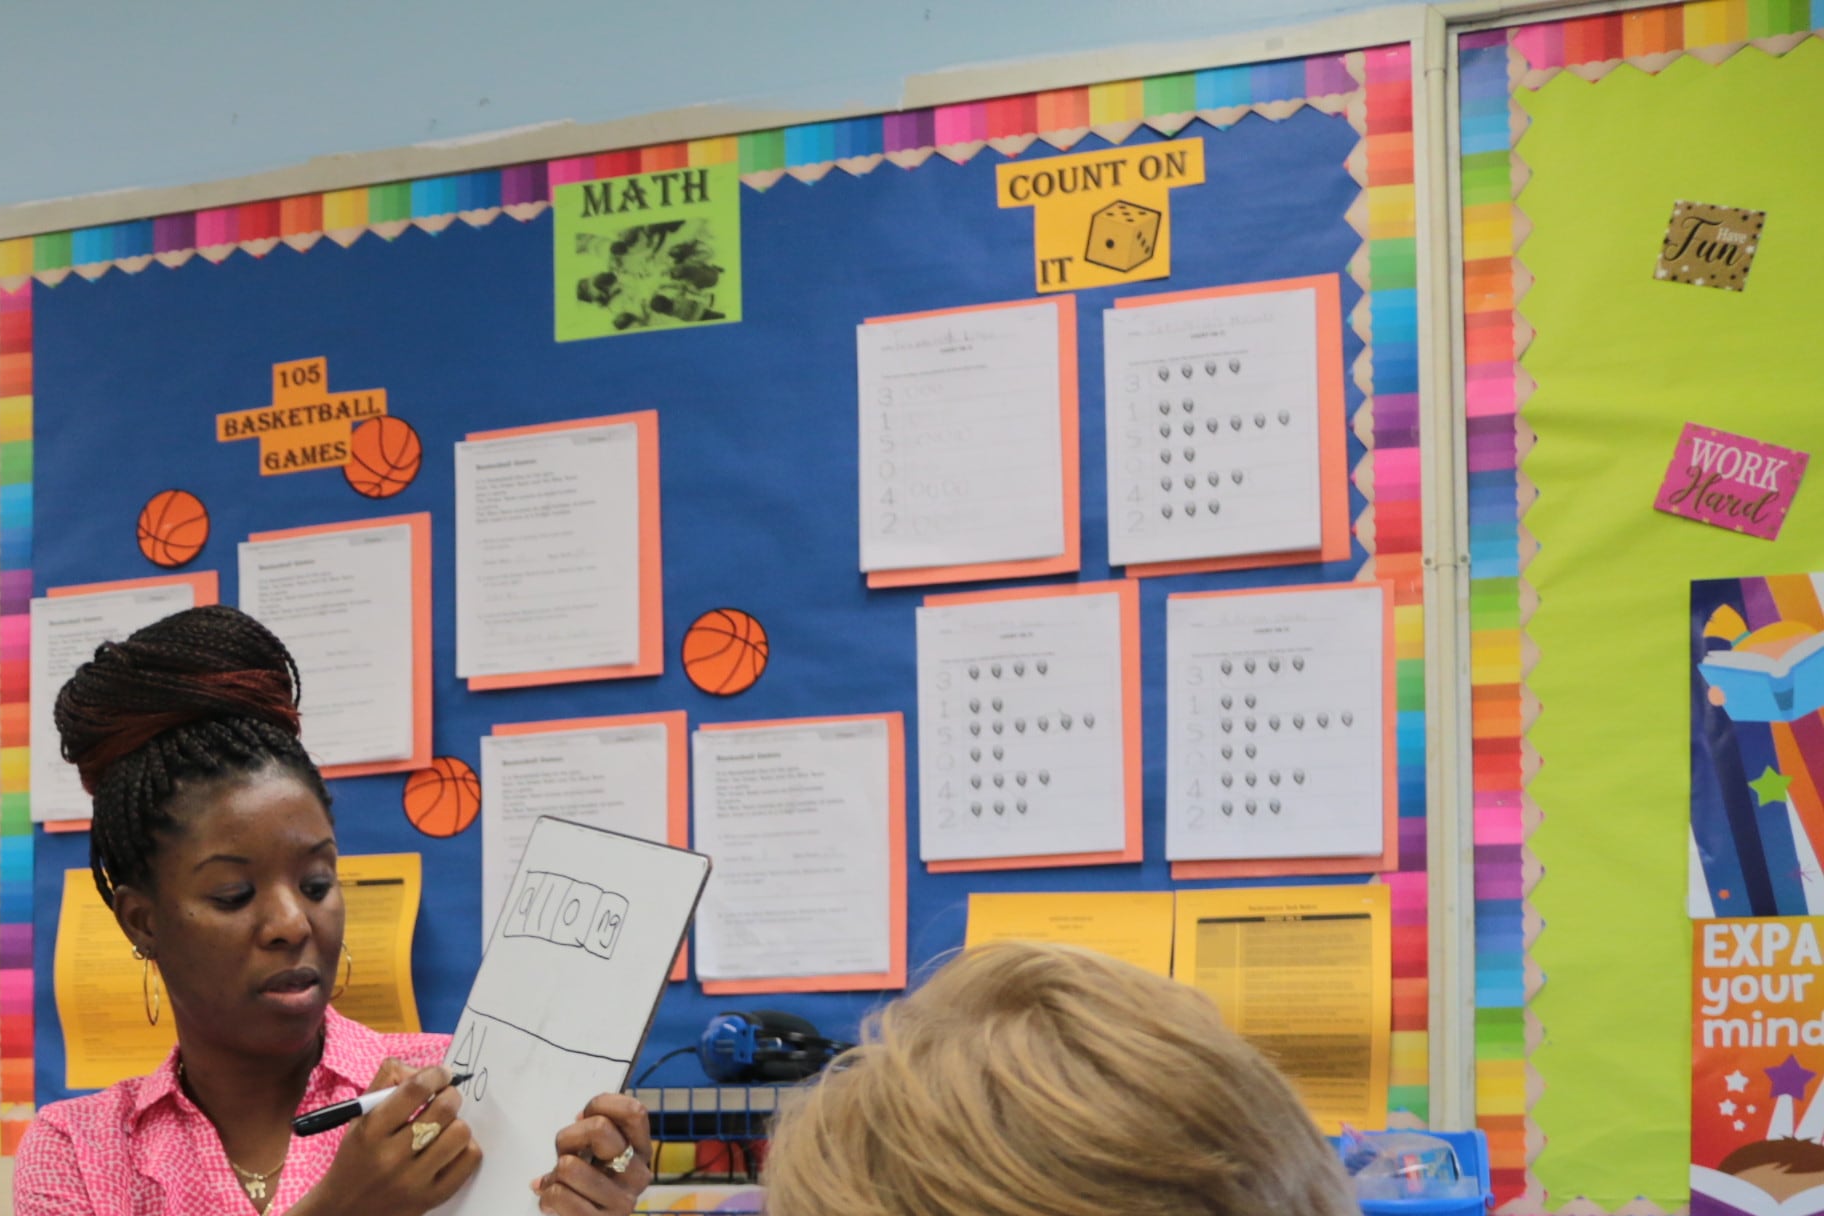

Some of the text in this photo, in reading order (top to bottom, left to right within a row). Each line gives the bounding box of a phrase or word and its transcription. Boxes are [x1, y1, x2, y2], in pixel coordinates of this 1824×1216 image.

[581, 169, 711, 219] MATH
[1009, 151, 1188, 203] COUNT ON
[1716, 228, 1748, 244] Have
[1039, 256, 1074, 286] IT
[279, 365, 321, 389] 105
[223, 396, 382, 439] BASKETBALL
[264, 440, 348, 471] GAMES
[1691, 438, 1789, 492] WORK
[880, 486, 895, 506] 4
[1669, 467, 1779, 524] Hard
[880, 512, 898, 535] 2
[1703, 921, 1823, 968] EXPA
[1701, 973, 1815, 1016] your
